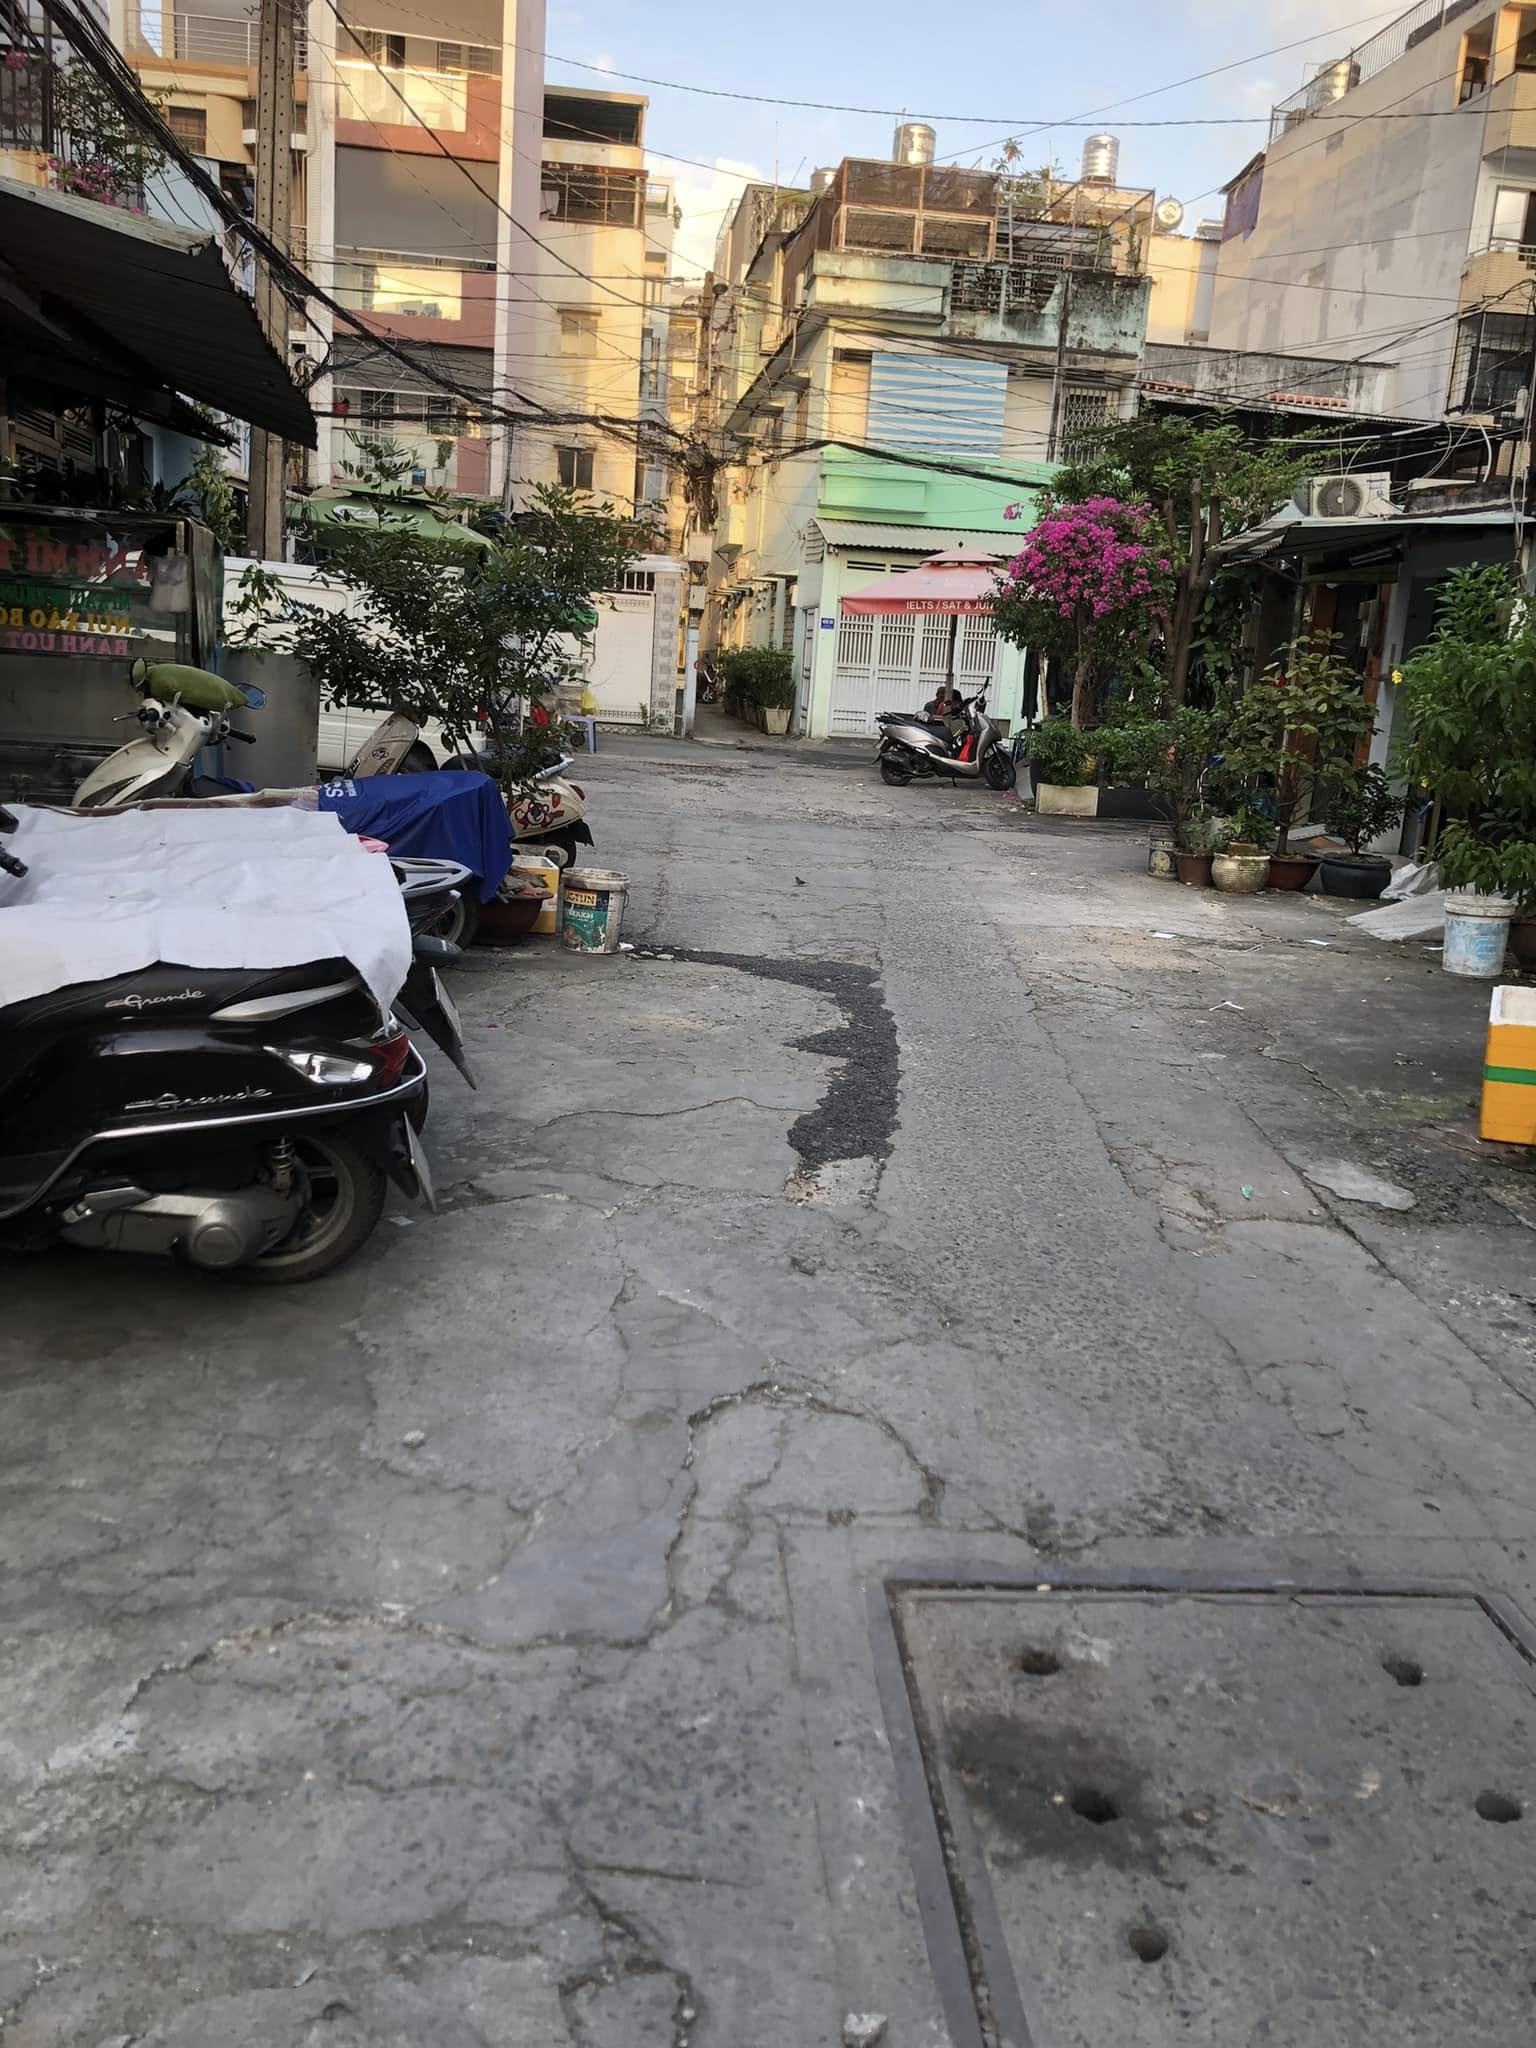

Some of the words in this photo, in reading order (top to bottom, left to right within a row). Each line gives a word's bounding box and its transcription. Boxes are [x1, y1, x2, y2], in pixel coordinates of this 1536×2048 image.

[906, 600, 934, 611] IELTS
[942, 600, 962, 610] SAT
[963, 600, 971, 610] &
[105, 987, 206, 1010] Grande
[125, 1086, 273, 1112] Grande
